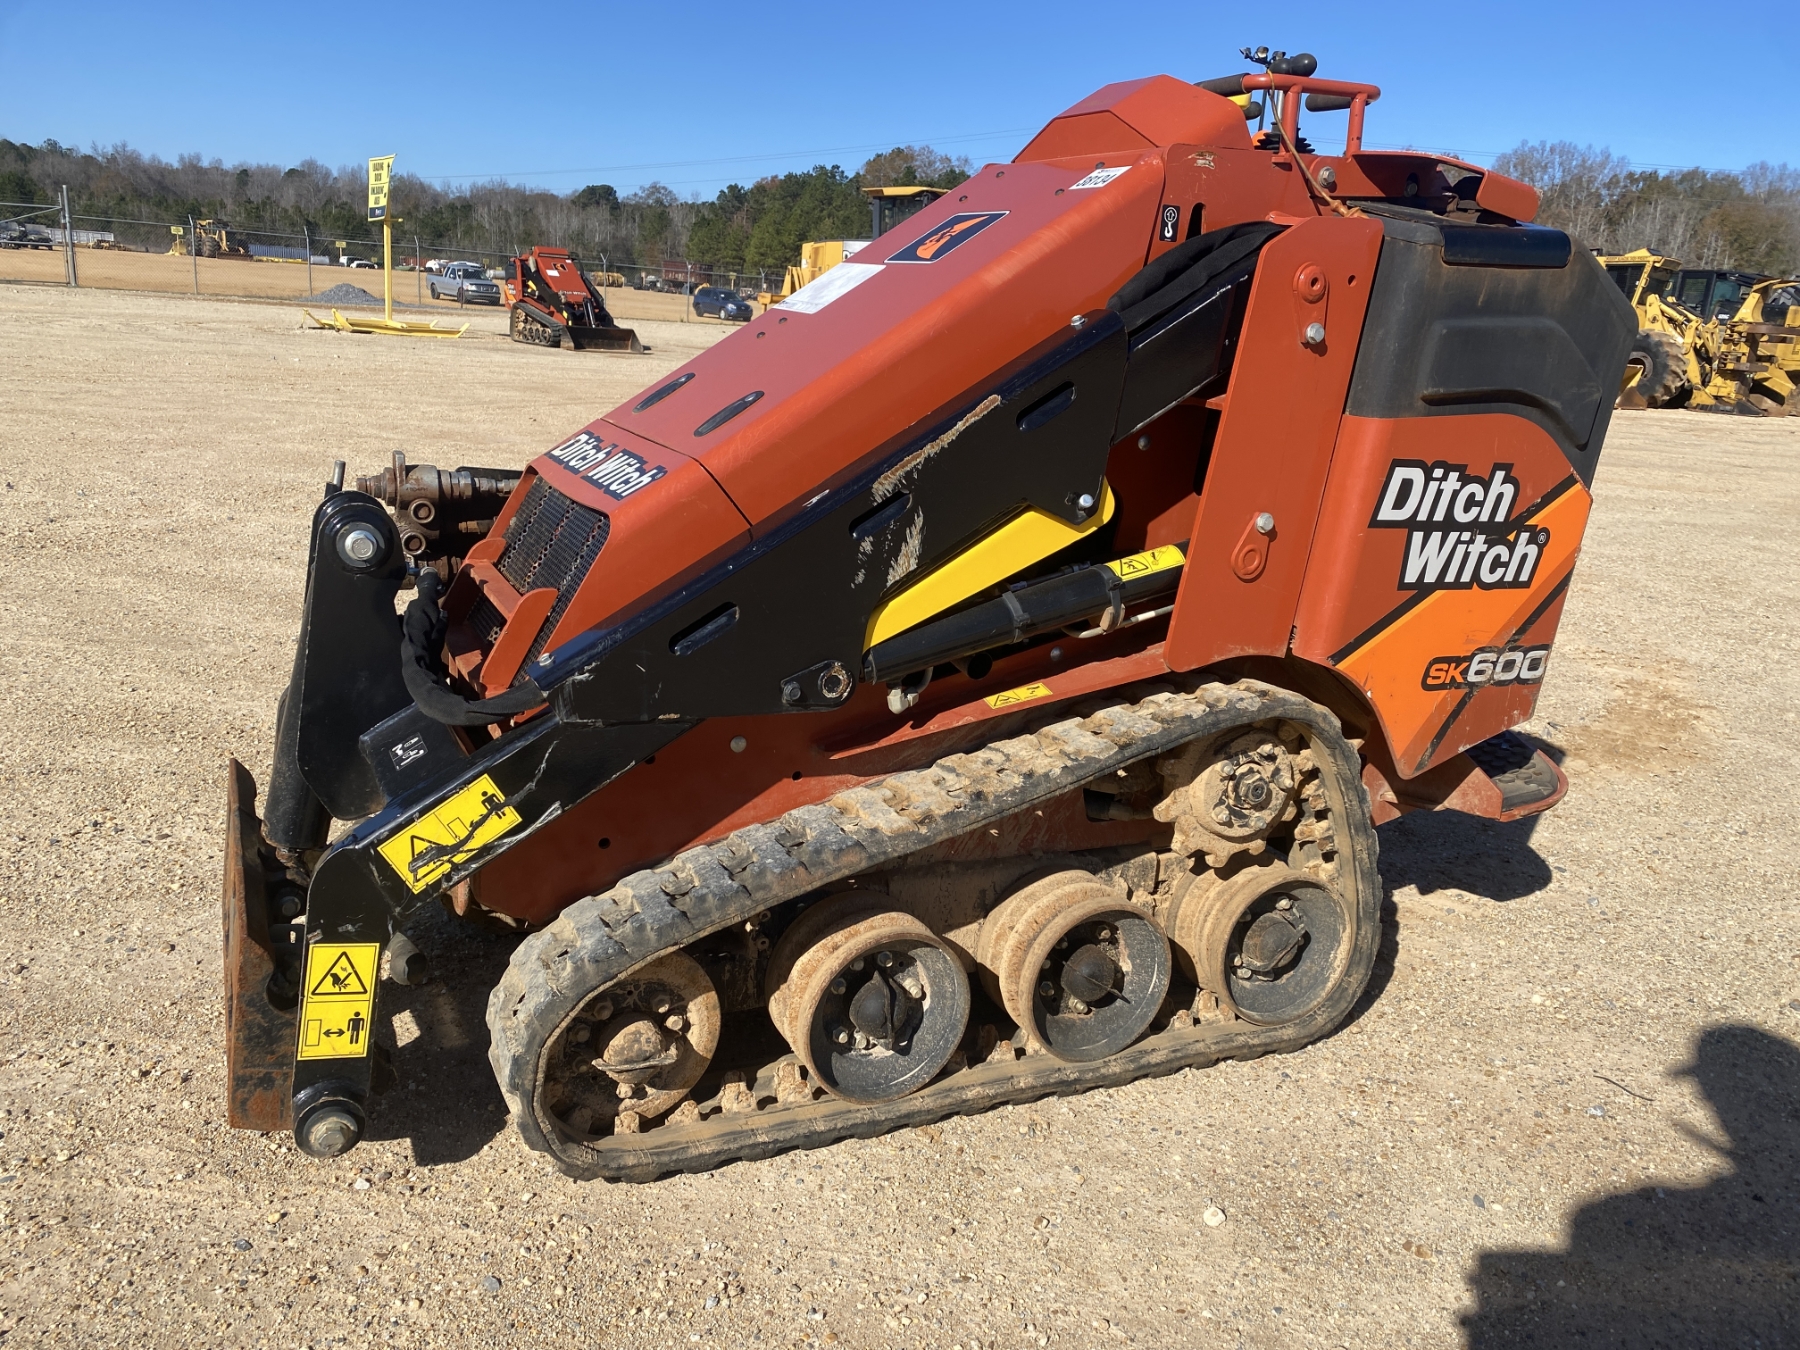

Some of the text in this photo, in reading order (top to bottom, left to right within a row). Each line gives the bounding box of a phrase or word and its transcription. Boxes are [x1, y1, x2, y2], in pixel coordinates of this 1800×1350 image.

[550, 433, 658, 497] Ditch Witch
[1376, 466, 1516, 523] Ditch
[1403, 531, 1539, 584] Witch
